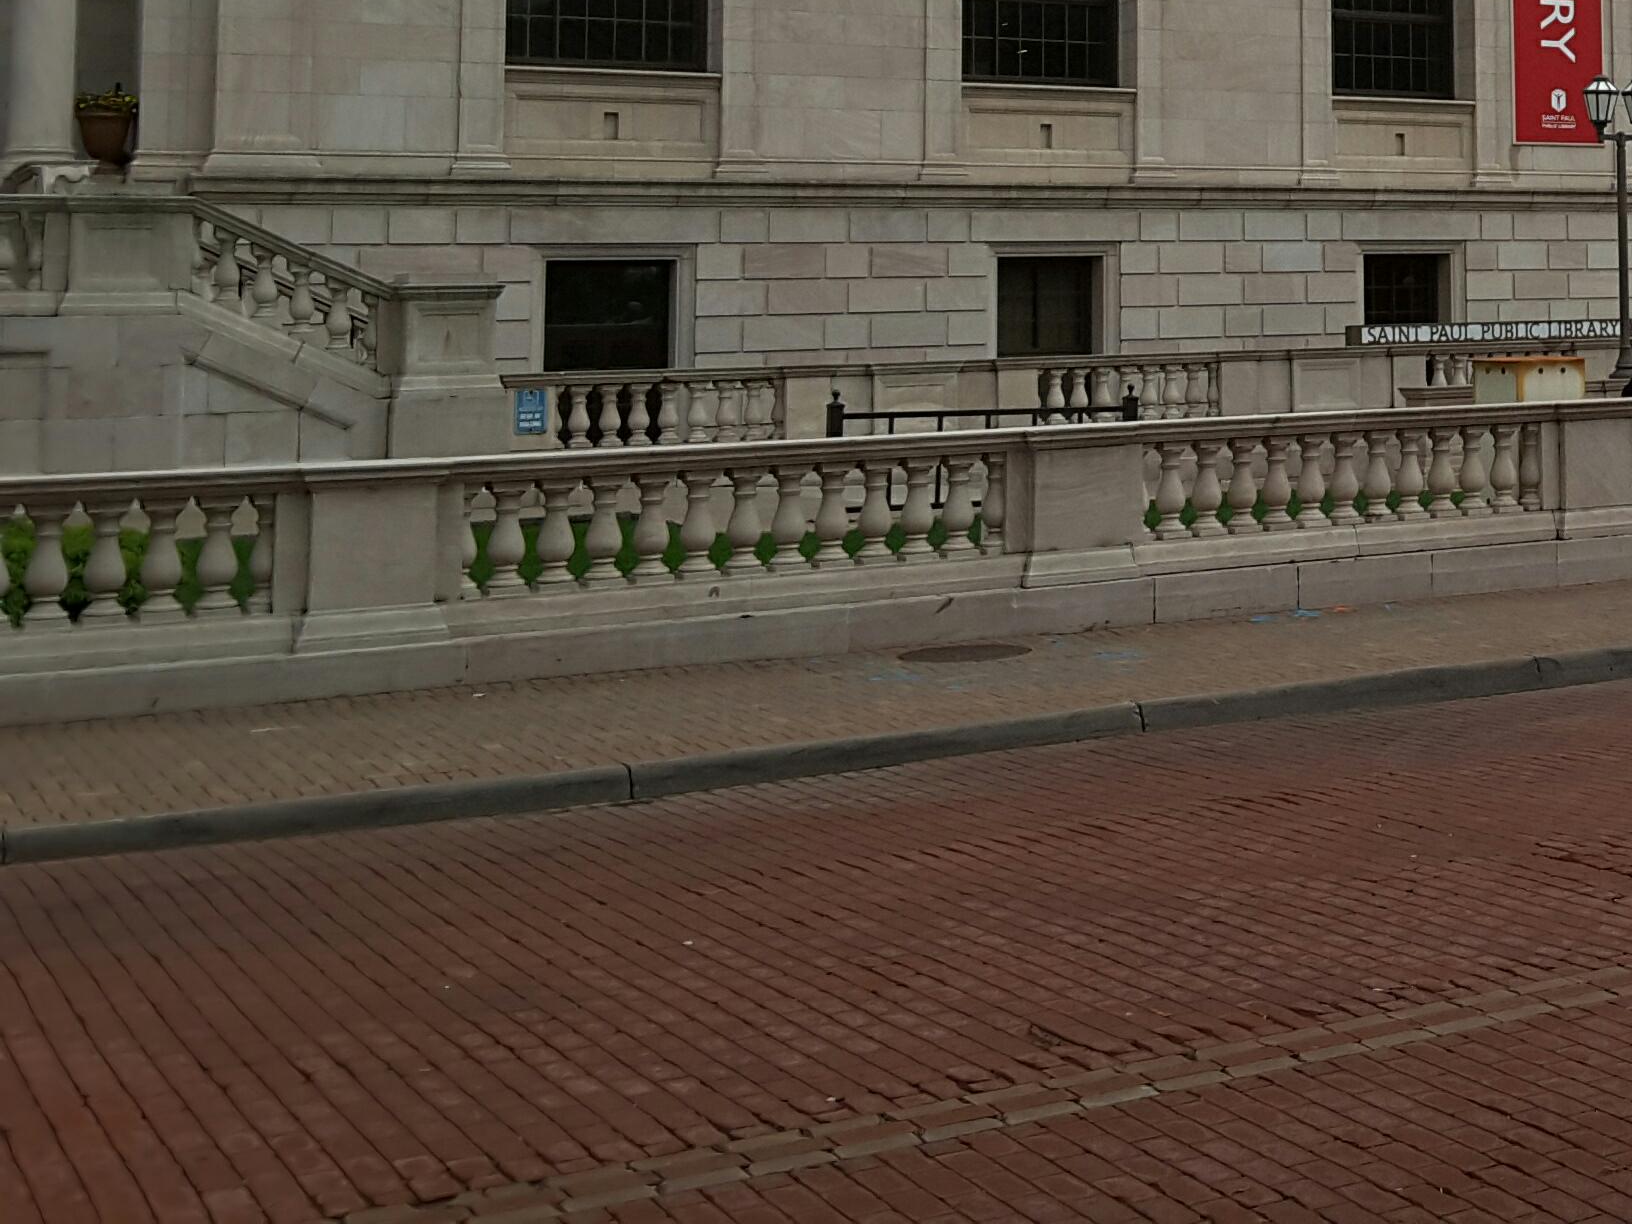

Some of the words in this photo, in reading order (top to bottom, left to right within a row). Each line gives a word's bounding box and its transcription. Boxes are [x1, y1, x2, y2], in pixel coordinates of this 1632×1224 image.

[1367, 326, 1422, 345] SAINT
[1430, 325, 1475, 343] PAUL
[1481, 323, 1541, 342] PUBLIC
[1548, 320, 1619, 339] LIBRARY
